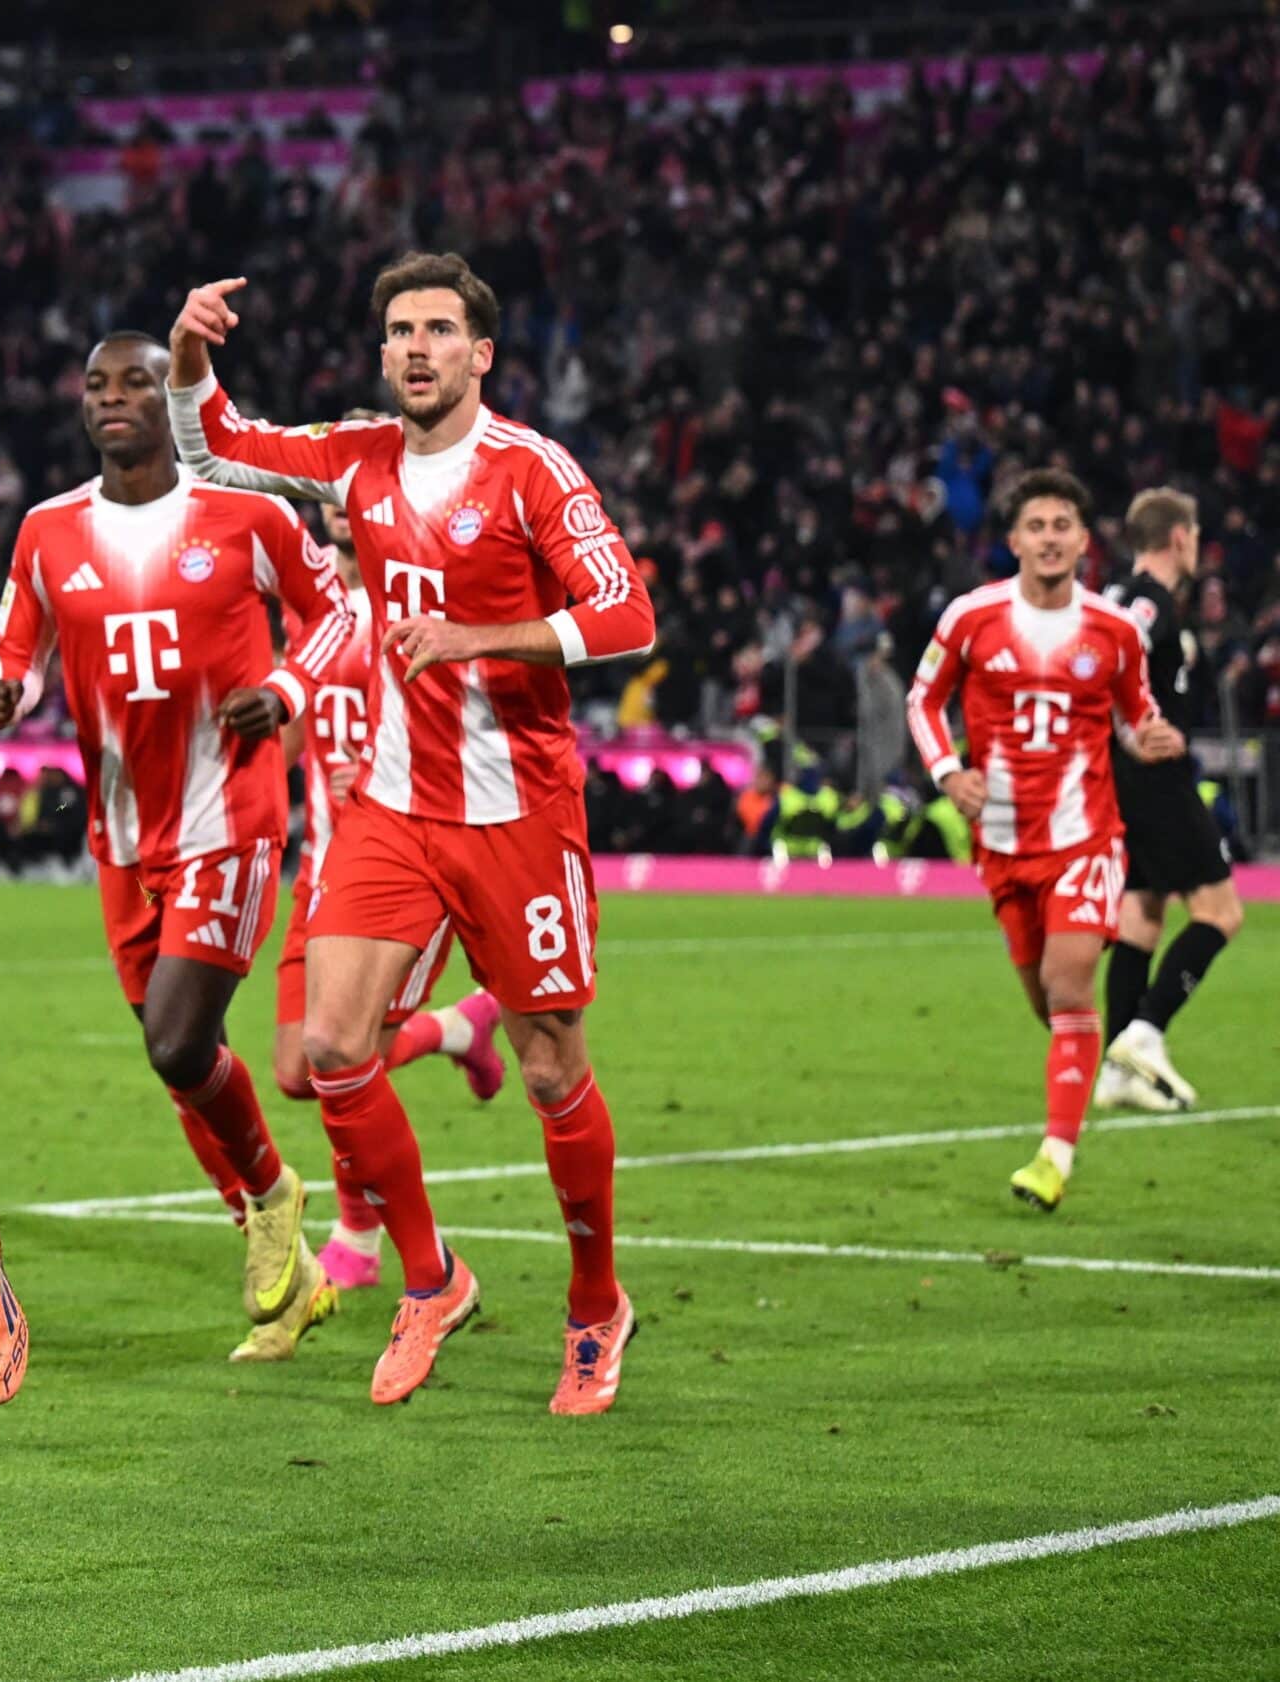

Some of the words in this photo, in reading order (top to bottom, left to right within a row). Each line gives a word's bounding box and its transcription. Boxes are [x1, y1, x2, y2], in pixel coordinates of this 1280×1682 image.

[104, 608, 181, 702] T
[1014, 690, 1071, 752] T
[174, 855, 239, 917] 11
[1054, 853, 1110, 900] 20
[525, 894, 567, 962] 8
